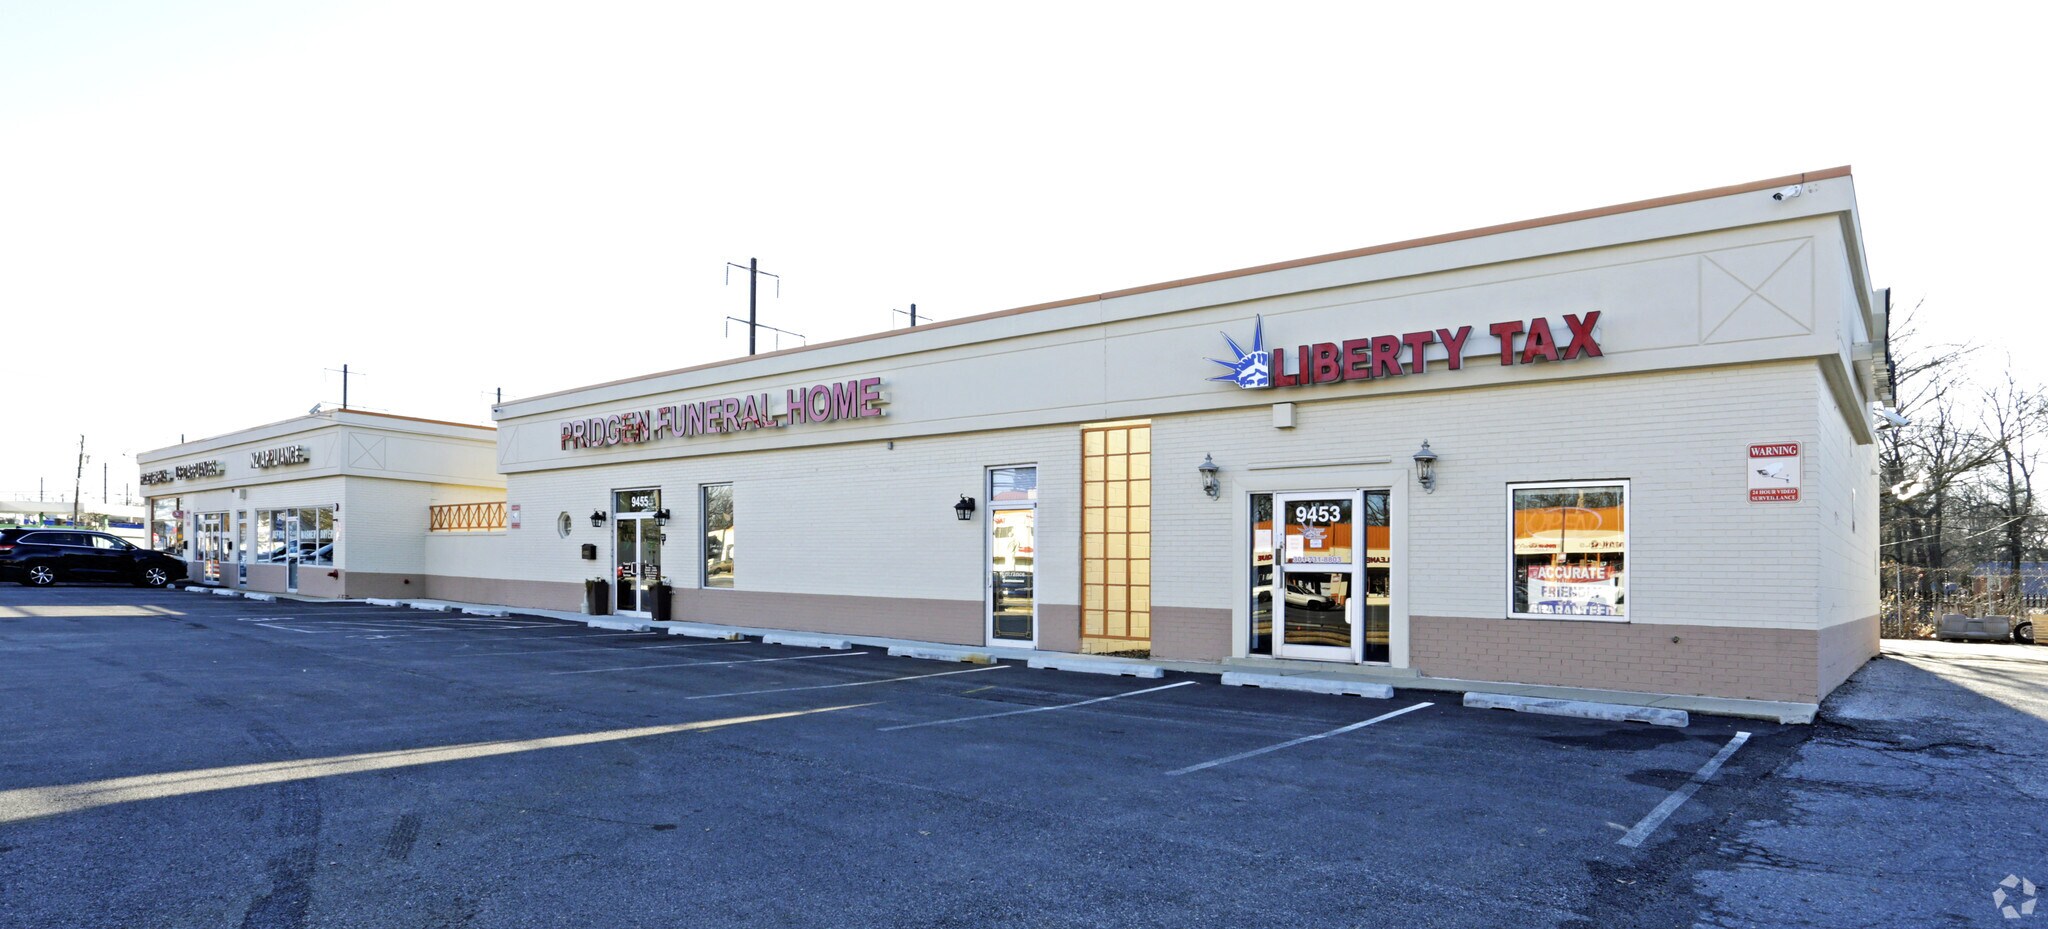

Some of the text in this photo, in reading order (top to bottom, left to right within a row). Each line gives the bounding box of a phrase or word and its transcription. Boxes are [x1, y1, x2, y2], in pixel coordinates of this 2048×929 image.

[1272, 310, 1606, 387] LIBERTY TAX
[560, 376, 882, 450] PRIDGEN FUNERAL HOME
[1751, 445, 1797, 456] WARNING
[631, 496, 649, 507] 9455
[1295, 505, 1341, 522] 9453
[1537, 566, 1606, 579] ACCURATE
